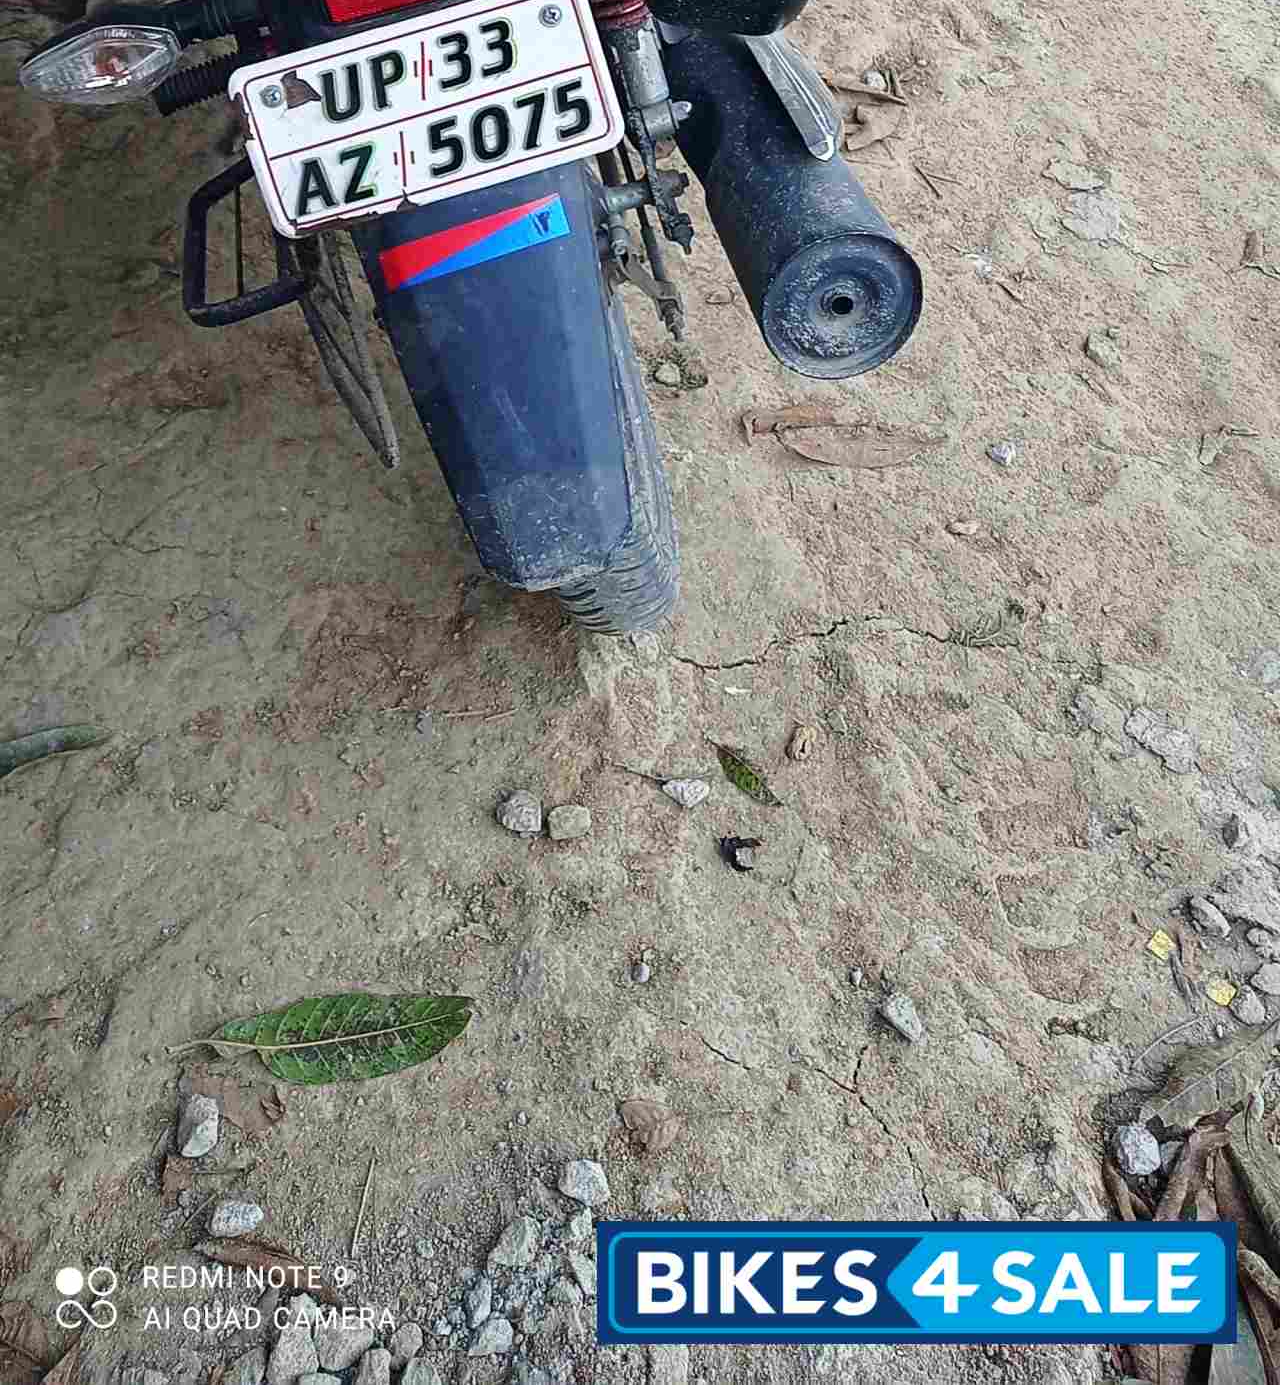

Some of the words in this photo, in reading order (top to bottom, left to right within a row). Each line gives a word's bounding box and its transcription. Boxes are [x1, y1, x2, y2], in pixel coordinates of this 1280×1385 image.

[318, 48, 405, 123] UP
[436, 18, 517, 93] 33
[296, 143, 378, 216] AZ
[427, 77, 592, 179] 5075
